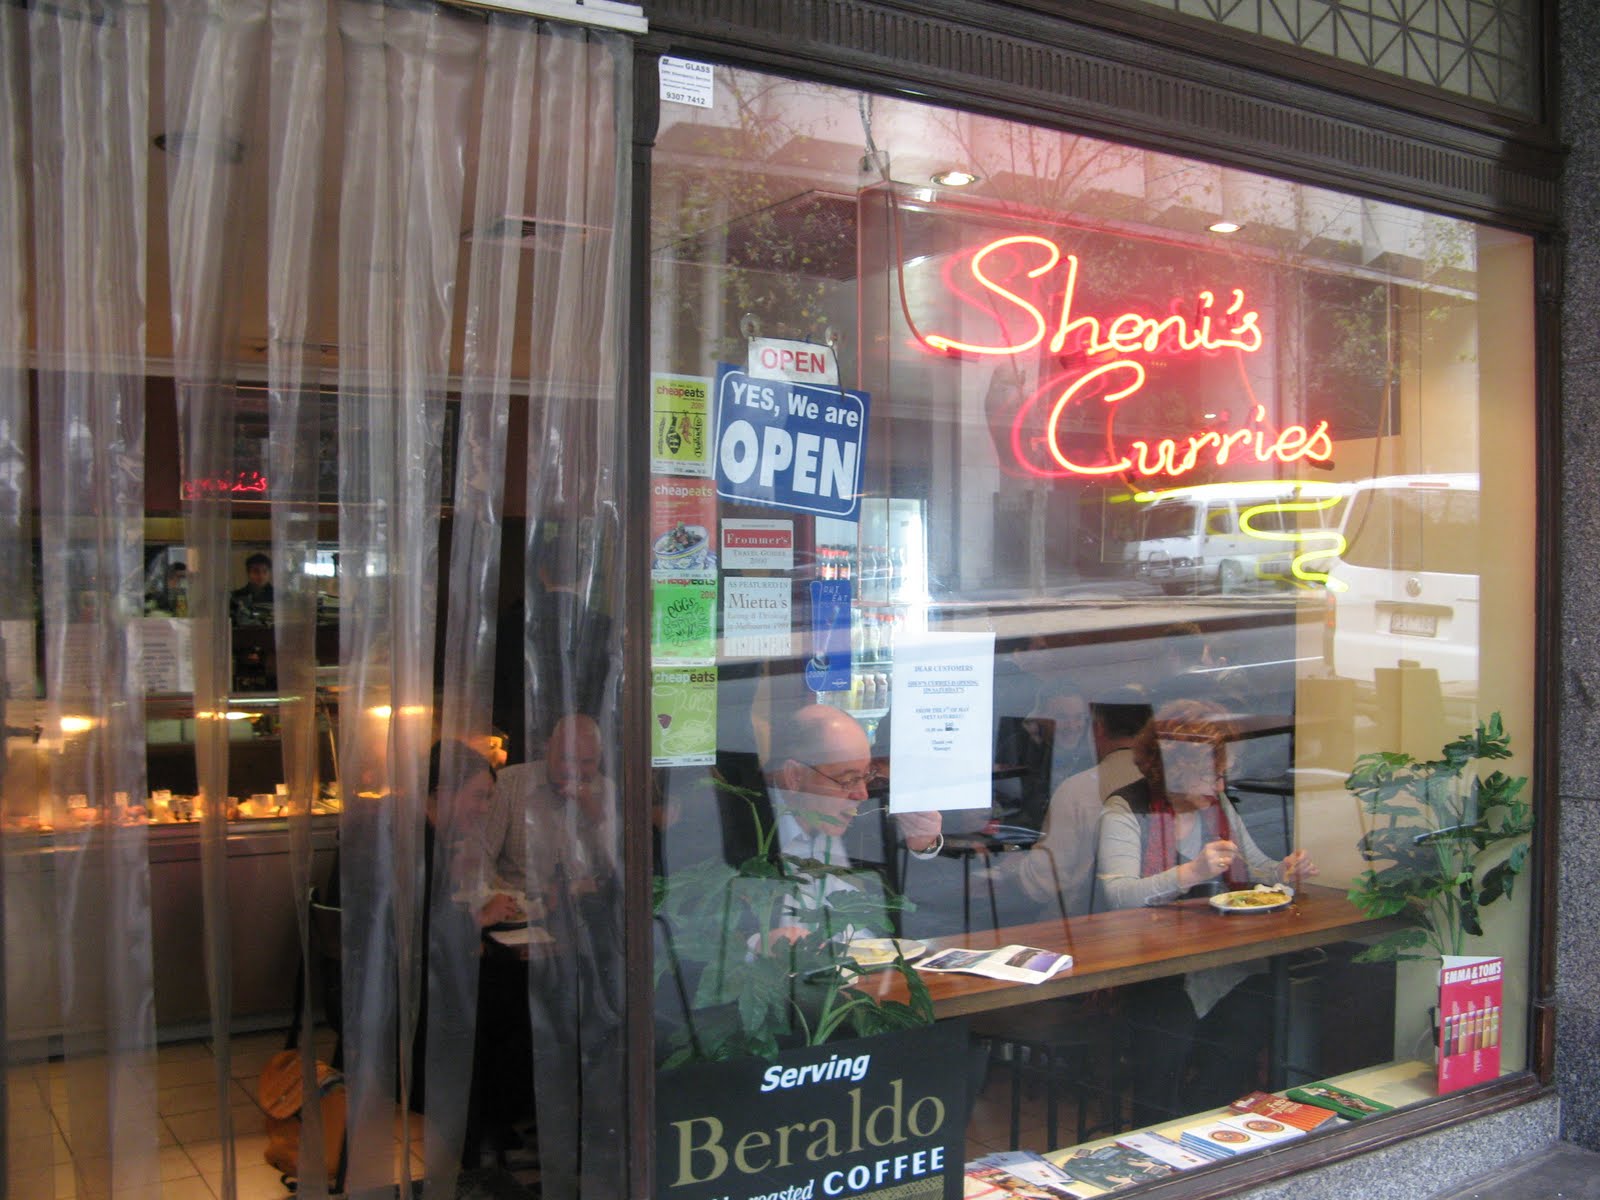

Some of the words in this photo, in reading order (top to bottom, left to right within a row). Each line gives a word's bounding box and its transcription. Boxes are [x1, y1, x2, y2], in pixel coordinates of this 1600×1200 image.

[685, 62, 710, 74] GLASS
[666, 91, 685, 100] 9307
[687, 95, 706, 105] 7412
[924, 234, 1263, 356] Sheni's
[760, 348, 826, 374] OPEN
[656, 386, 705, 398] cheapeats
[731, 381, 780, 417] YES,
[787, 392, 819, 419] We
[824, 406, 859, 428] are
[1047, 359, 1334, 476] Curries
[720, 419, 857, 501] OPEN
[654, 484, 713, 498] cheapeats
[727, 532, 789, 545] Frommer's
[728, 593, 788, 609] Mietta's
[654, 671, 715, 683] cheapeats
[1444, 968, 1471, 984] EMMA
[1471, 966, 1478, 979] &
[761, 1054, 870, 1092] Serving
[670, 1078, 945, 1188] Beraldo
[823, 1146, 944, 1196] COFFEE
